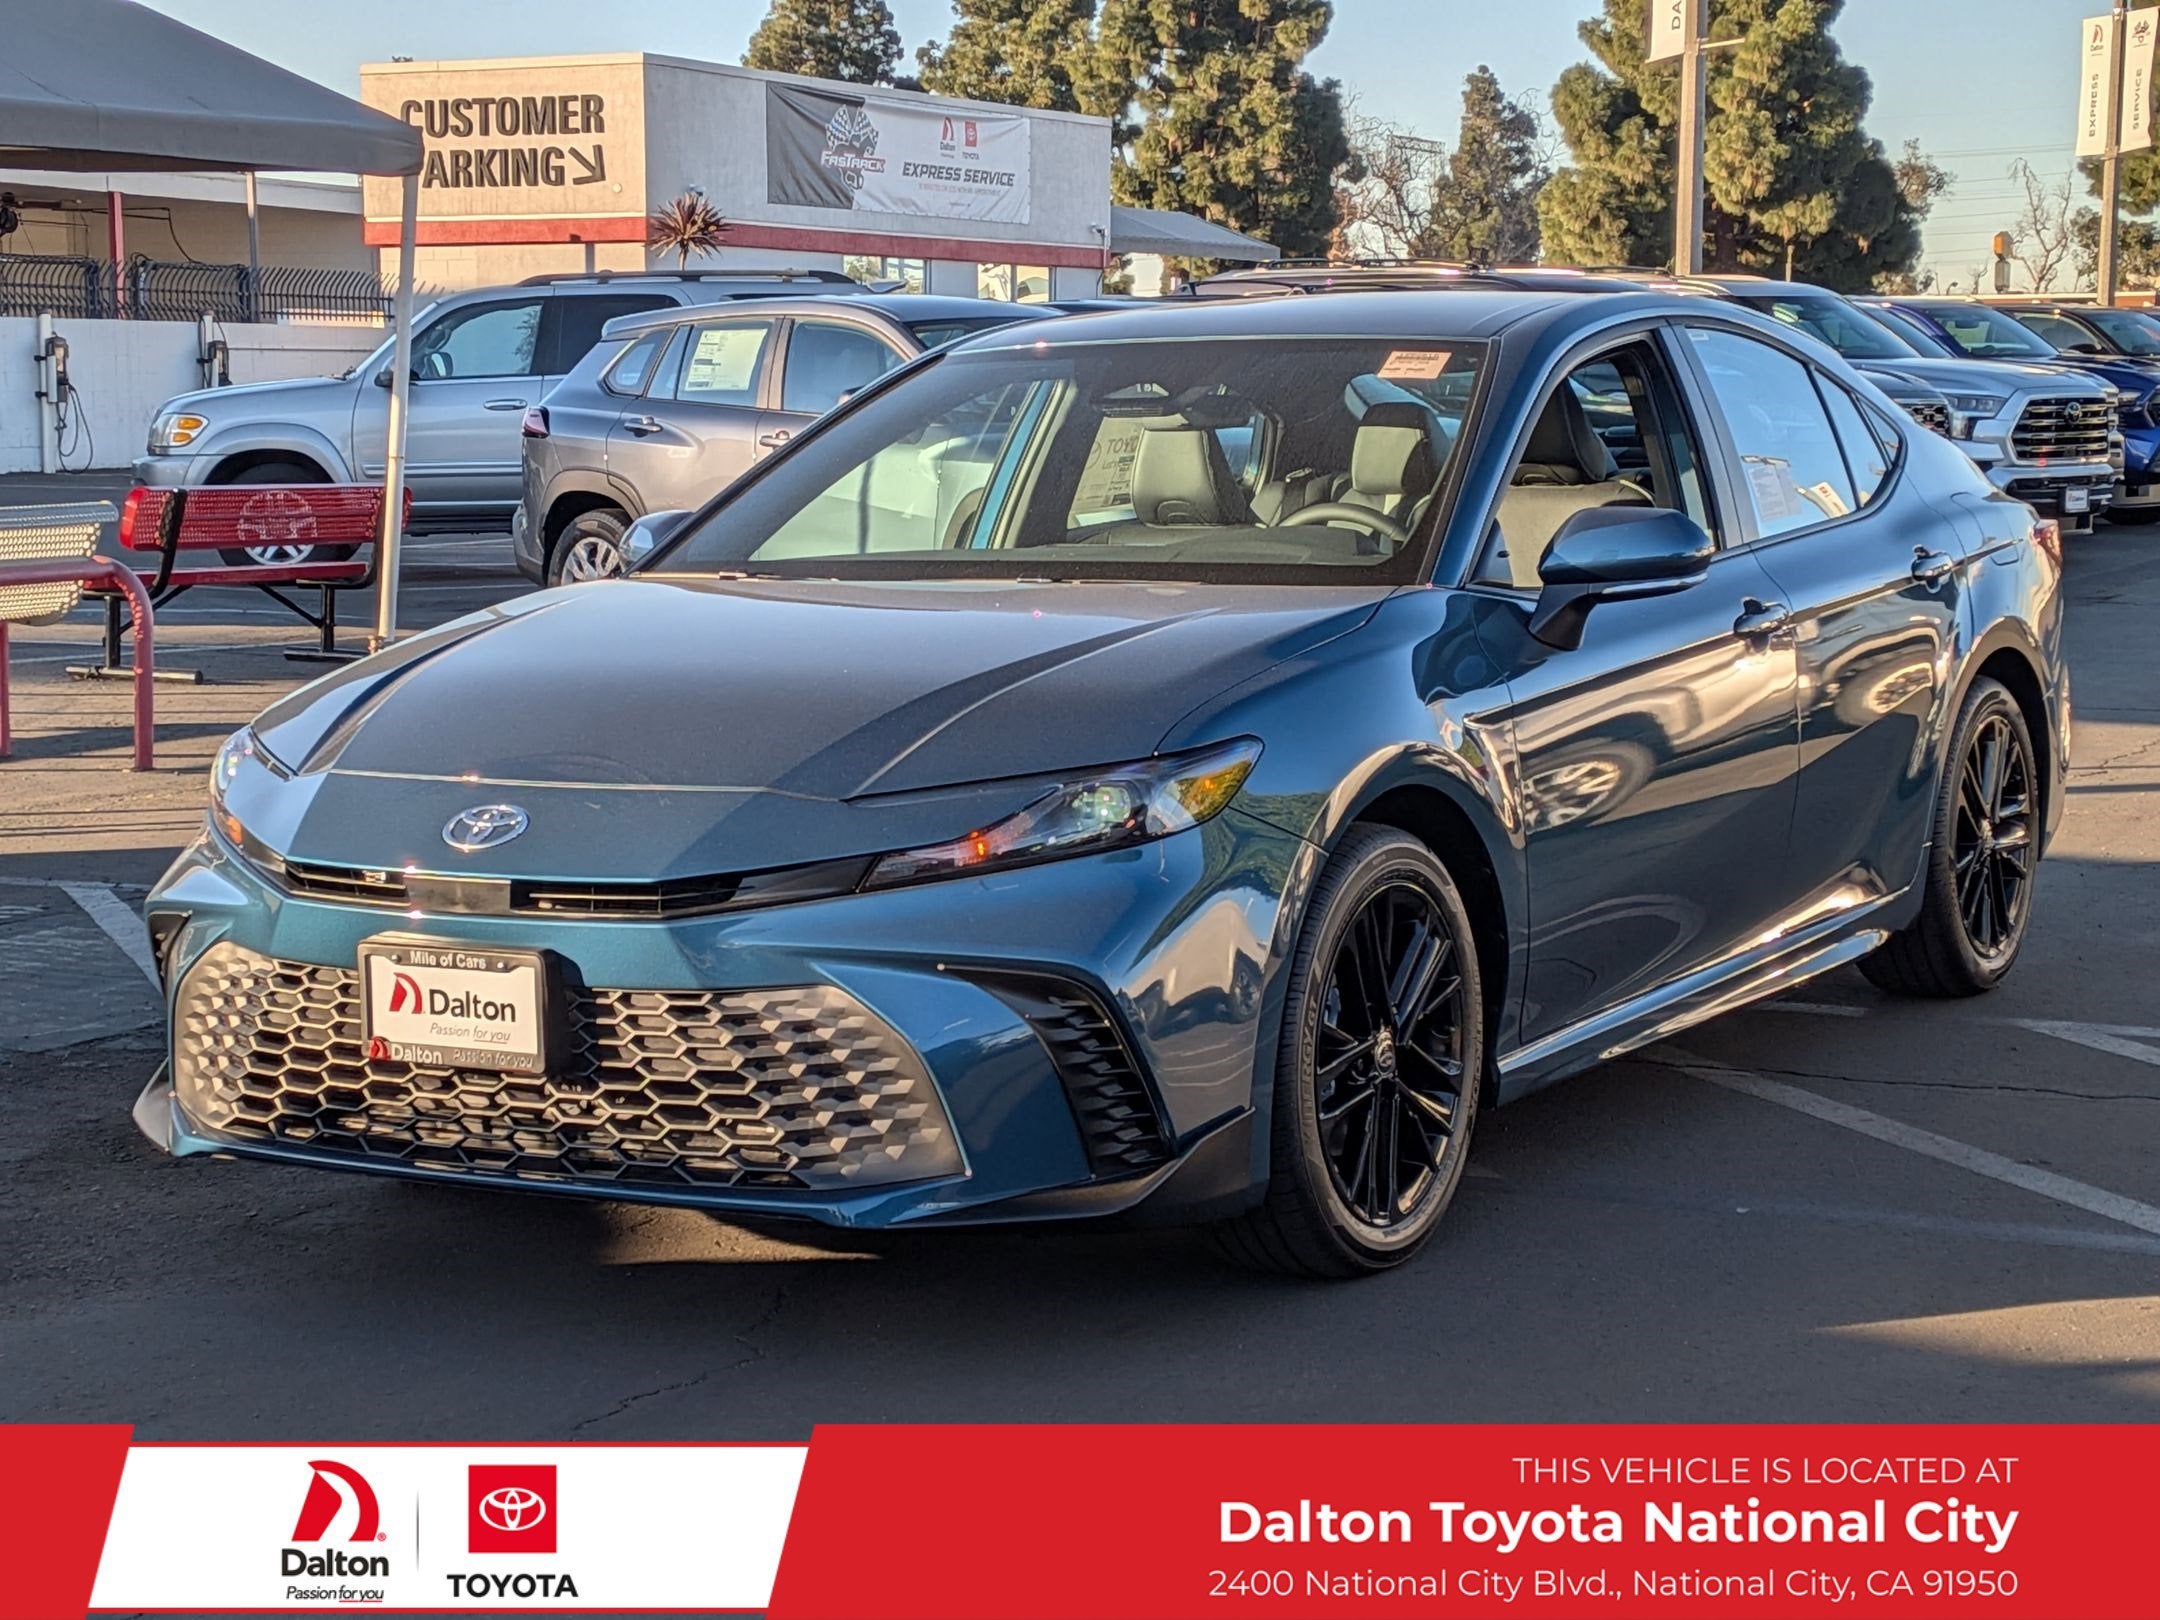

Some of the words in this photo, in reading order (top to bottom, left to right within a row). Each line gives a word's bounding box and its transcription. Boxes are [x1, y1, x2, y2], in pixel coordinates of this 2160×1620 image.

[400, 94, 605, 138] CUSTOMER
[2088, 73, 2099, 137] EXPRESS
[2132, 68, 2143, 130] SERVICE
[422, 146, 566, 188] ARKING
[902, 161, 962, 182] EXPRESS
[963, 168, 1016, 187] SERVICE
[410, 950, 437, 966] Mile
[440, 954, 453, 967] of
[456, 955, 487, 969] Cars
[429, 988, 516, 1022] Dalton
[430, 1022, 470, 1037] Passion
[473, 1025, 488, 1040] for
[489, 1030, 512, 1043] you
[391, 1044, 444, 1065] Dalton
[453, 1049, 493, 1064] Passion
[495, 1052, 512, 1067] for
[514, 1056, 534, 1069] you
